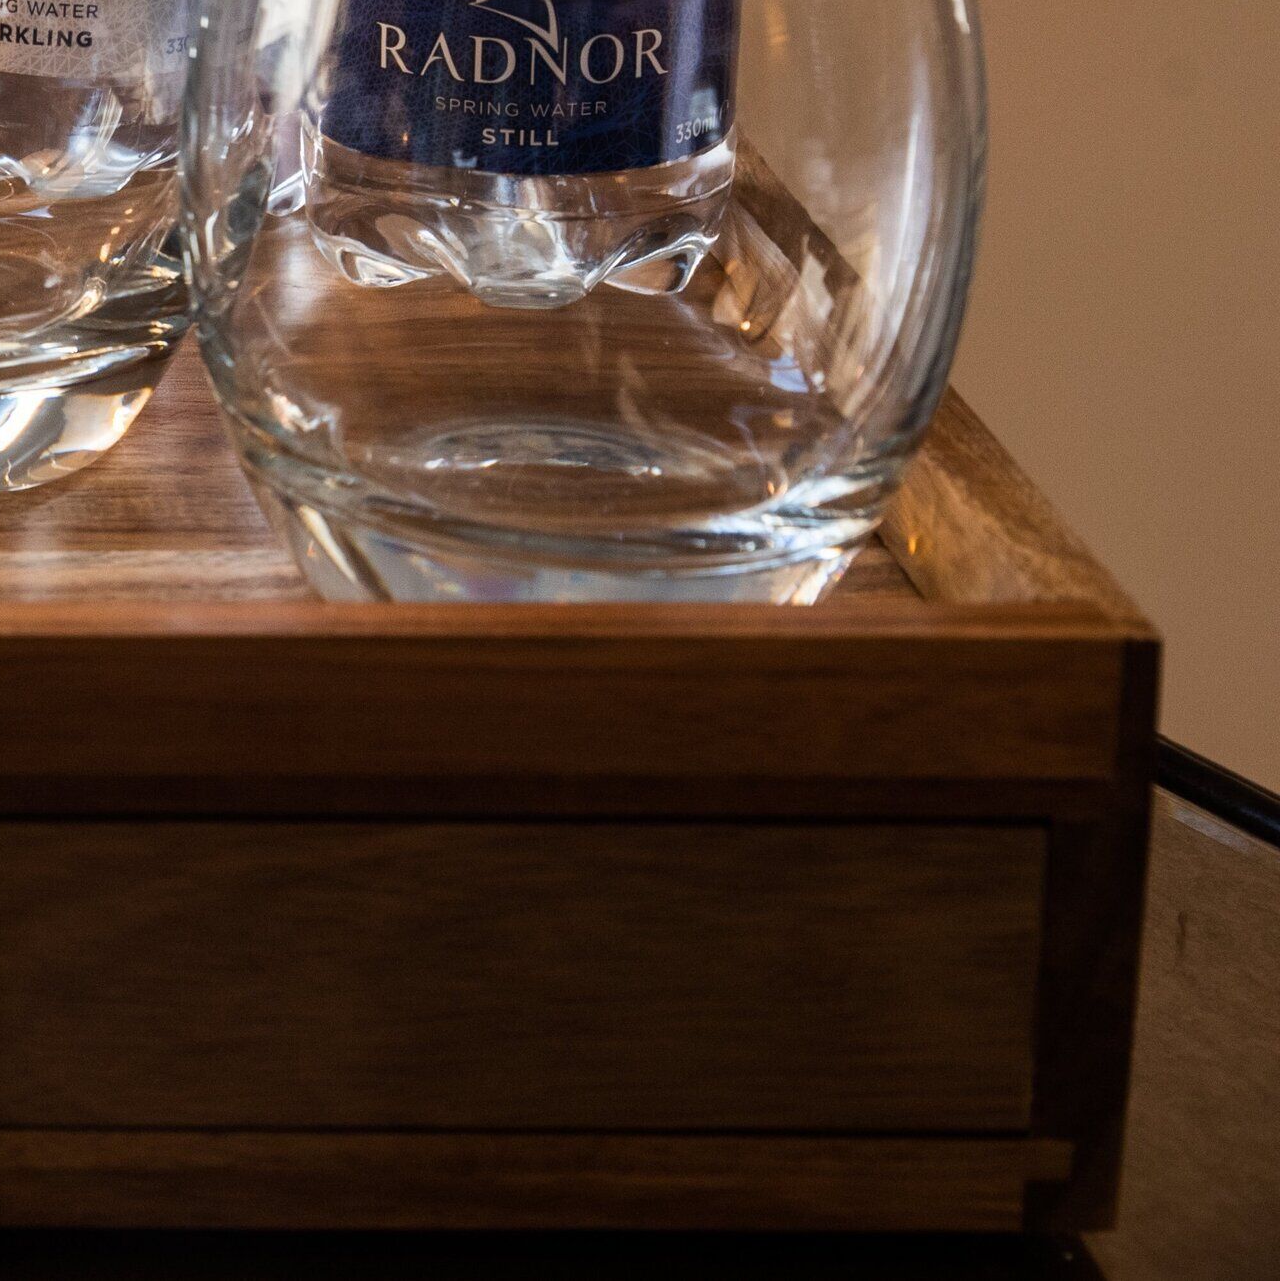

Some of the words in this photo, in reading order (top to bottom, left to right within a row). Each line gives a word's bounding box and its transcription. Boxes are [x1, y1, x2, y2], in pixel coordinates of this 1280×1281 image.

[27, 0, 99, 19] WATER
[376, 21, 669, 86] RADNOR
[435, 96, 520, 118] SPRING
[529, 100, 608, 118] WATER
[481, 127, 560, 147] STILL
